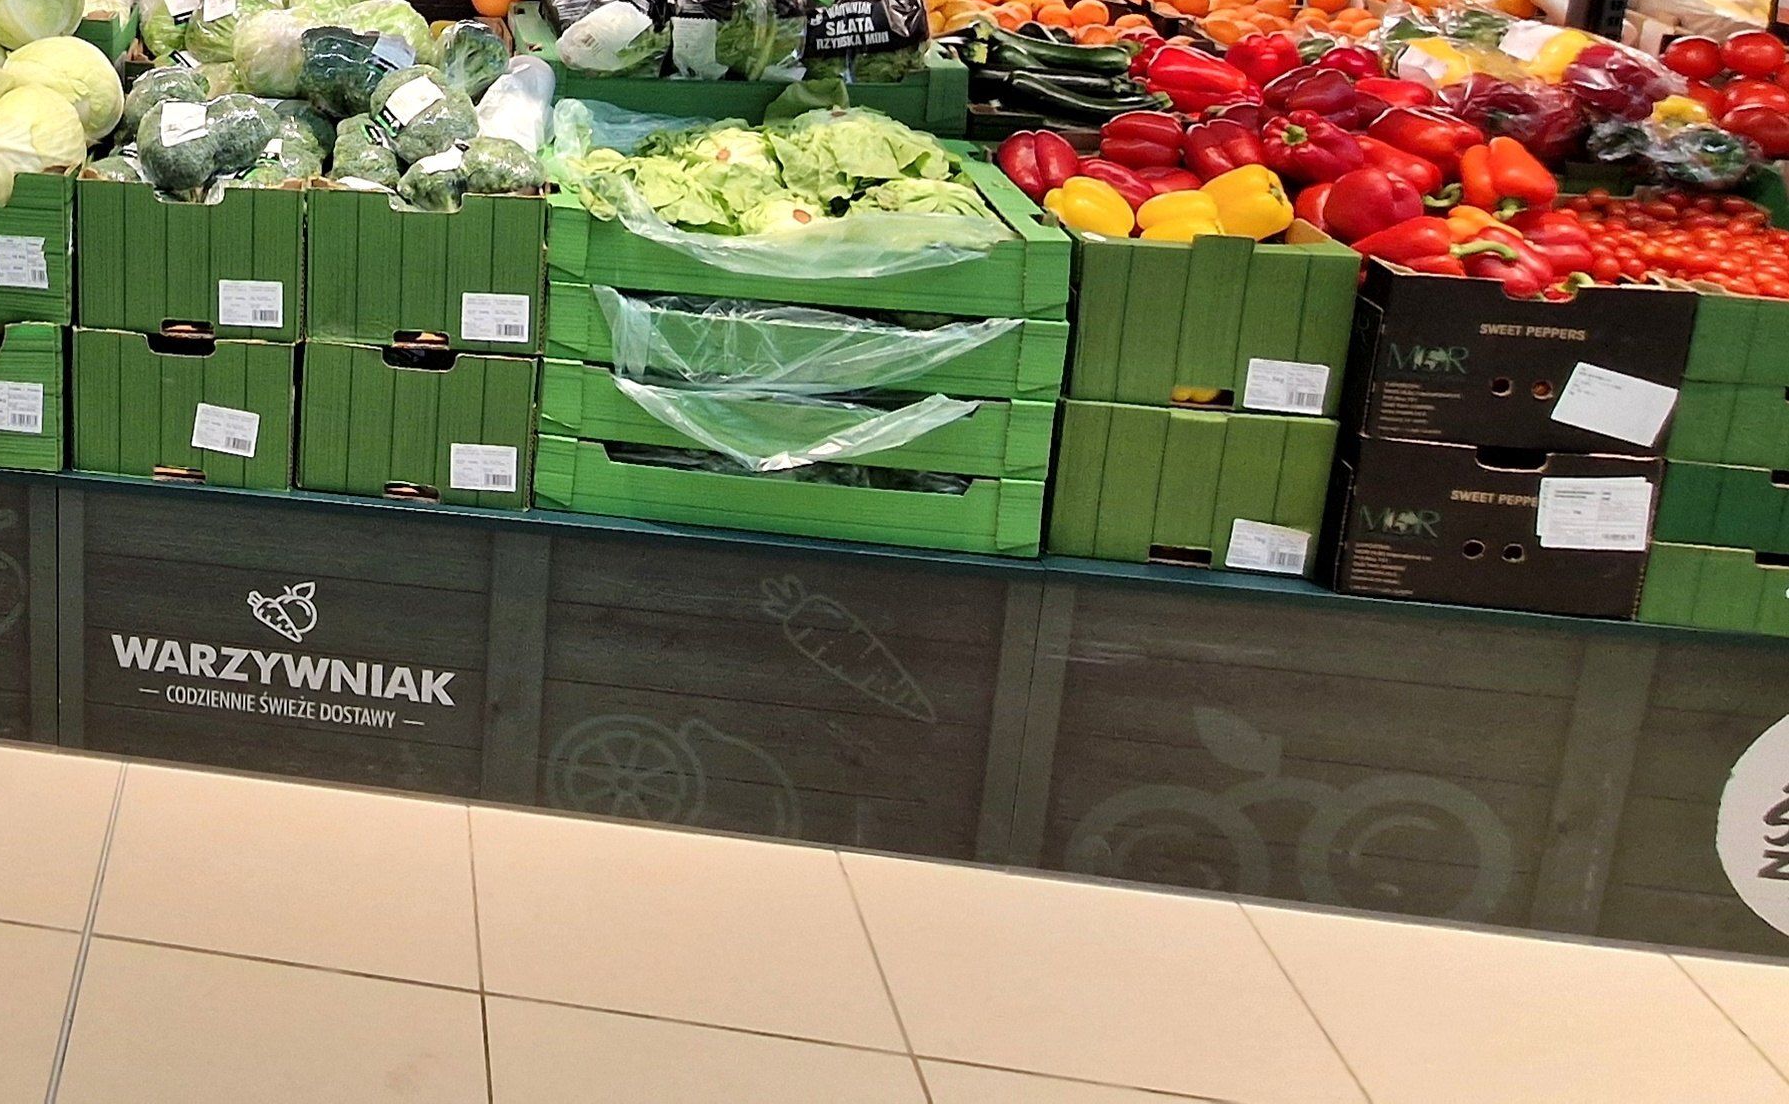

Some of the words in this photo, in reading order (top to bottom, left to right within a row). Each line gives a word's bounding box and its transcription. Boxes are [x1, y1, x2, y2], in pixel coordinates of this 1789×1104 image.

[1479, 323, 1523, 336] SWEET
[1525, 325, 1586, 341] PEPPERS
[1450, 490, 1495, 504] SWEET
[1498, 492, 1539, 507] PEPPE
[112, 633, 456, 707] WARZYWNIAK
[166, 684, 256, 713] CODZIENNIE
[259, 691, 316, 720] ŚWIEŻE
[320, 704, 396, 729] DOSTAWY
